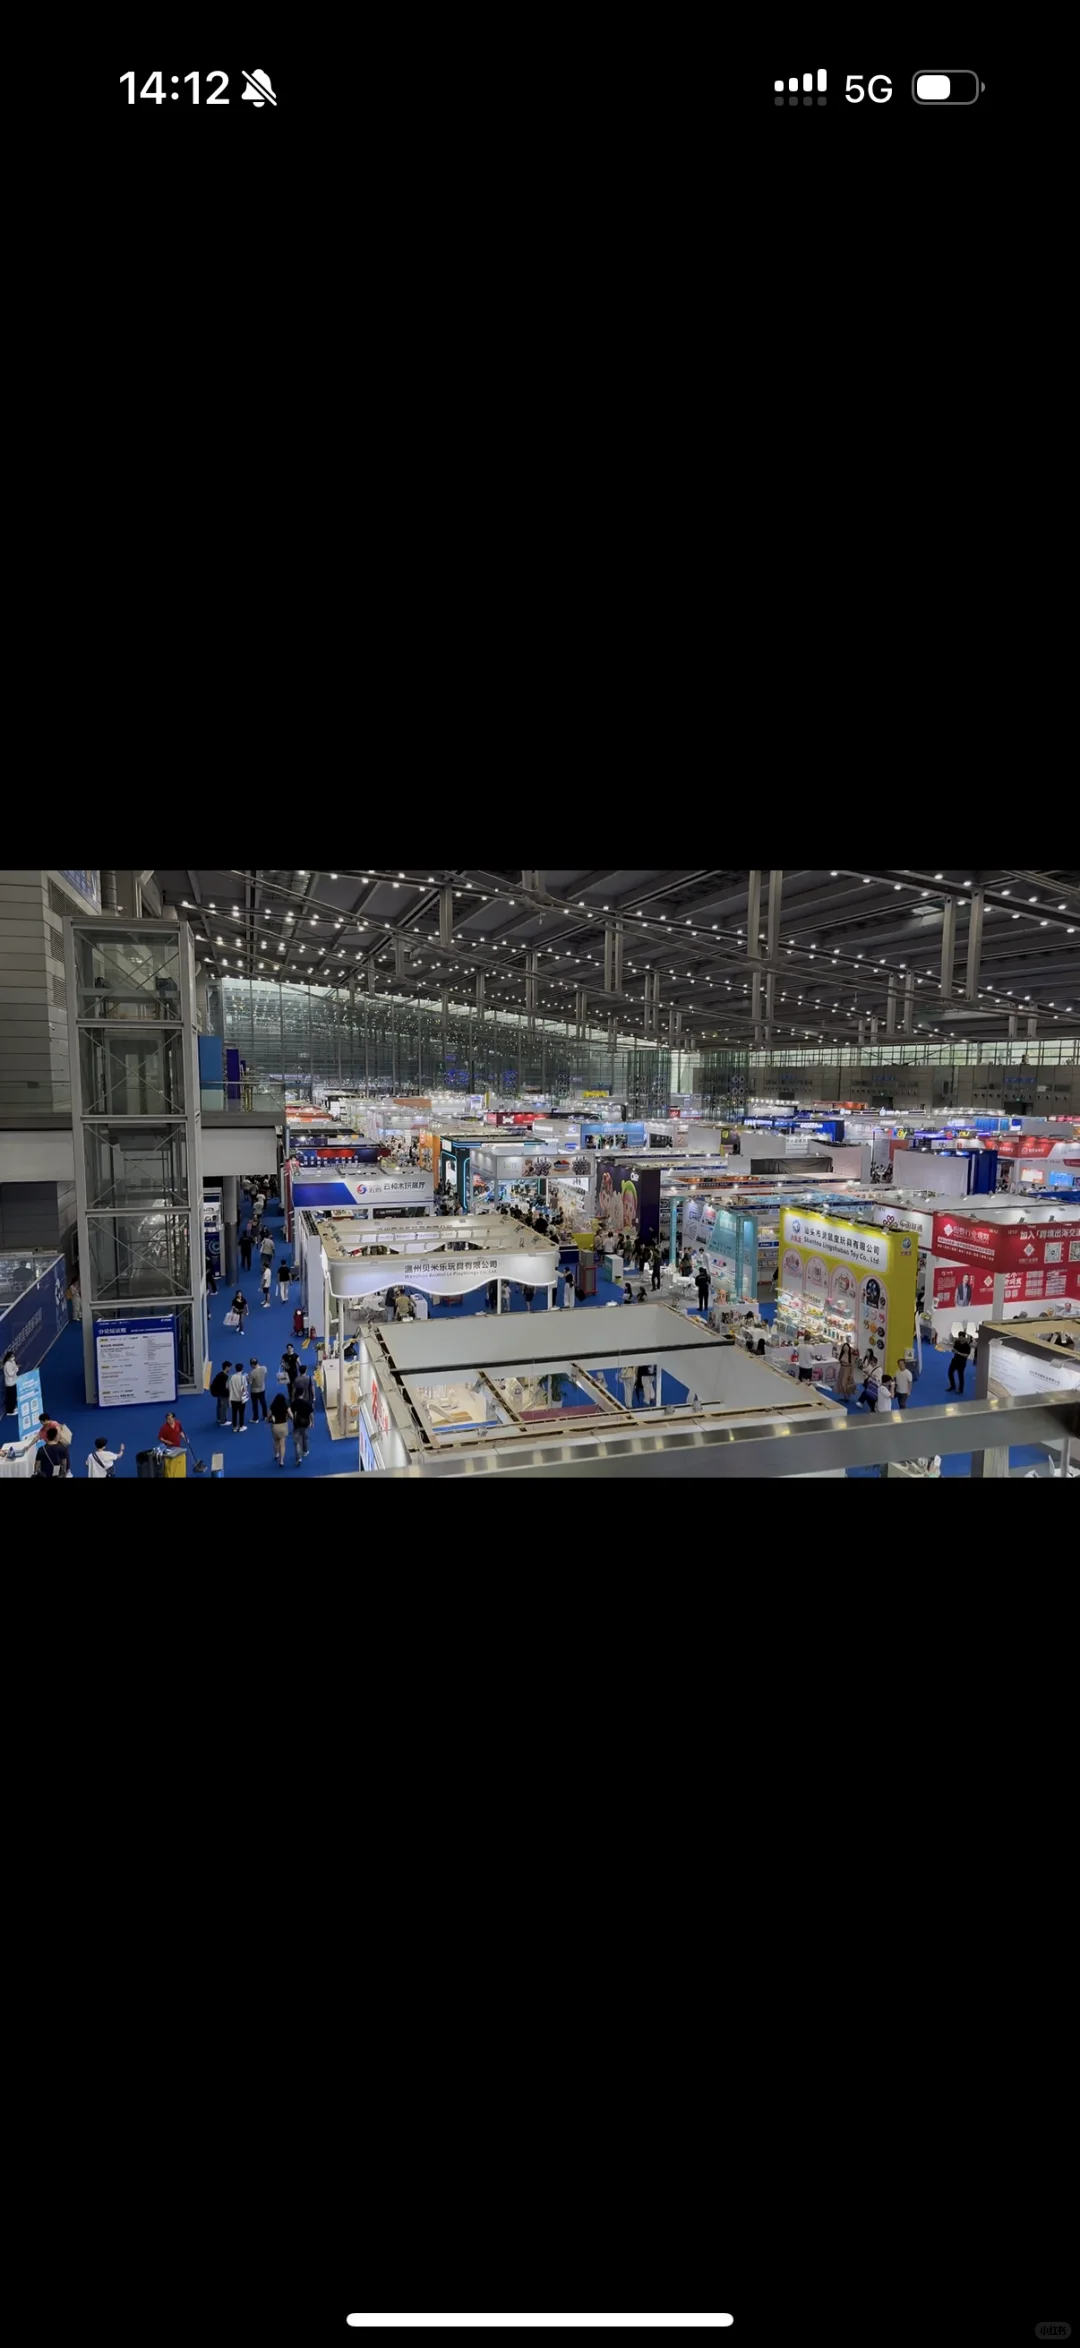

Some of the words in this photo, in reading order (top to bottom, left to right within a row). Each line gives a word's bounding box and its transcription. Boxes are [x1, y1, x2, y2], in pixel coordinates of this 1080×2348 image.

[804, 1236, 822, 1247] Shantou
[850, 1249, 859, 1260] Toy
[404, 1260, 498, 1273] 温州贝米乐玩具有限公司
